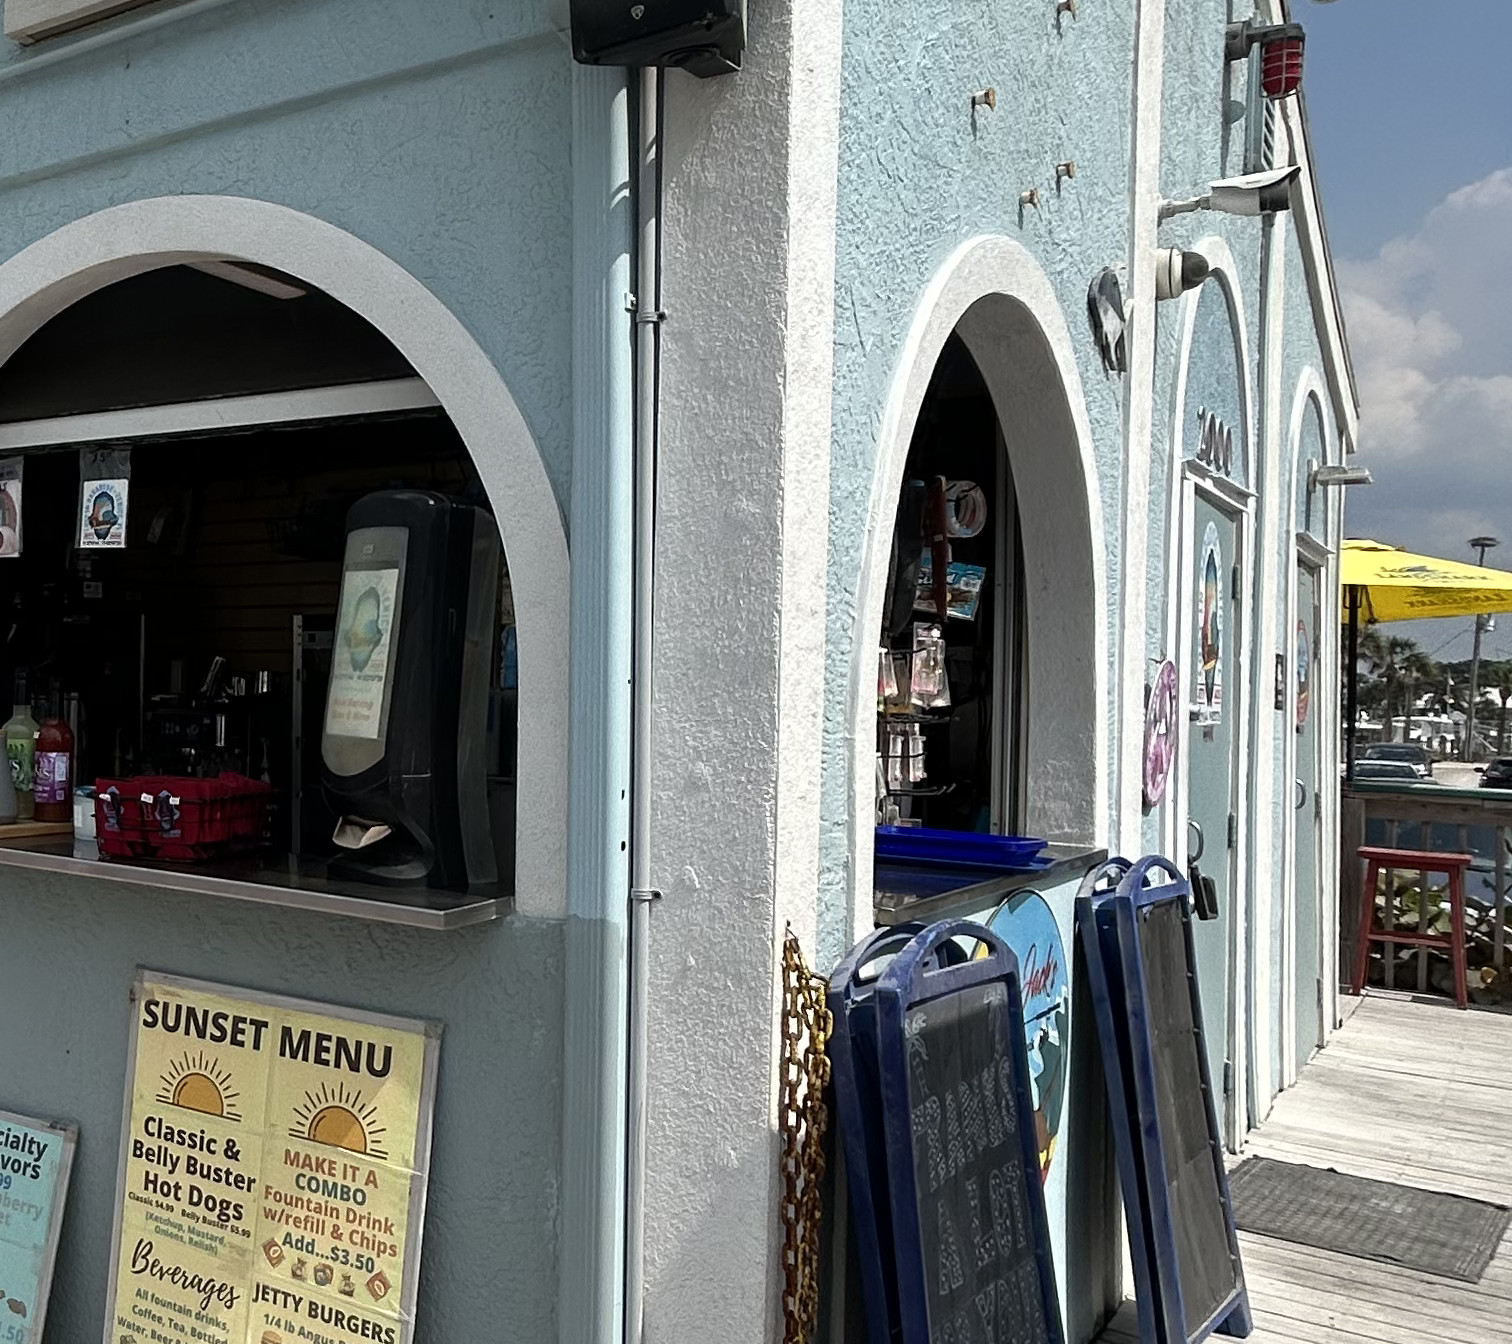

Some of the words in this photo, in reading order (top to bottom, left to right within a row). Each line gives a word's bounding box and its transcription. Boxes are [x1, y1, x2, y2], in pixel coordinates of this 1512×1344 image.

[143, 999, 268, 1051] SUNSET
[279, 1025, 392, 1077] MENU
[144, 1116, 217, 1155] Classic
[223, 1138, 241, 1162] &
[911, 1056, 1017, 1194] THANKS
[132, 1139, 180, 1175] Belly
[186, 1155, 256, 1193] Buster
[283, 1148, 337, 1178] MAKE
[343, 1163, 360, 1183] IT
[364, 1169, 378, 1189] A
[295, 1172, 367, 1206] COMBO
[128, 1191, 153, 1207] Classic
[155, 1200, 174, 1213] $4.99
[181, 1209, 200, 1223] Belly
[202, 1216, 229, 1231] Buster
[230, 1224, 251, 1238] $5.99
[144, 1170, 182, 1202] Hot
[188, 1184, 244, 1223] Dogs
[264, 1185, 340, 1220] Fountain
[345, 1207, 395, 1236] Drink
[263, 1206, 326, 1236] w/refill
[330, 1223, 343, 1242] &
[349, 1229, 398, 1258] Chips
[130, 1238, 241, 1311] Beverages
[252, 1281, 304, 1314] JETTY
[117, 1315, 148, 1338] Water,
[132, 1304, 165, 1327] Coffee,
[168, 1317, 188, 1335] Tea,
[135, 1288, 149, 1301] All
[151, 1292, 192, 1318] fountain
[195, 1310, 229, 1334] drinks,
[263, 1313, 281, 1329] 1/4
[284, 1320, 295, 1335] lb
